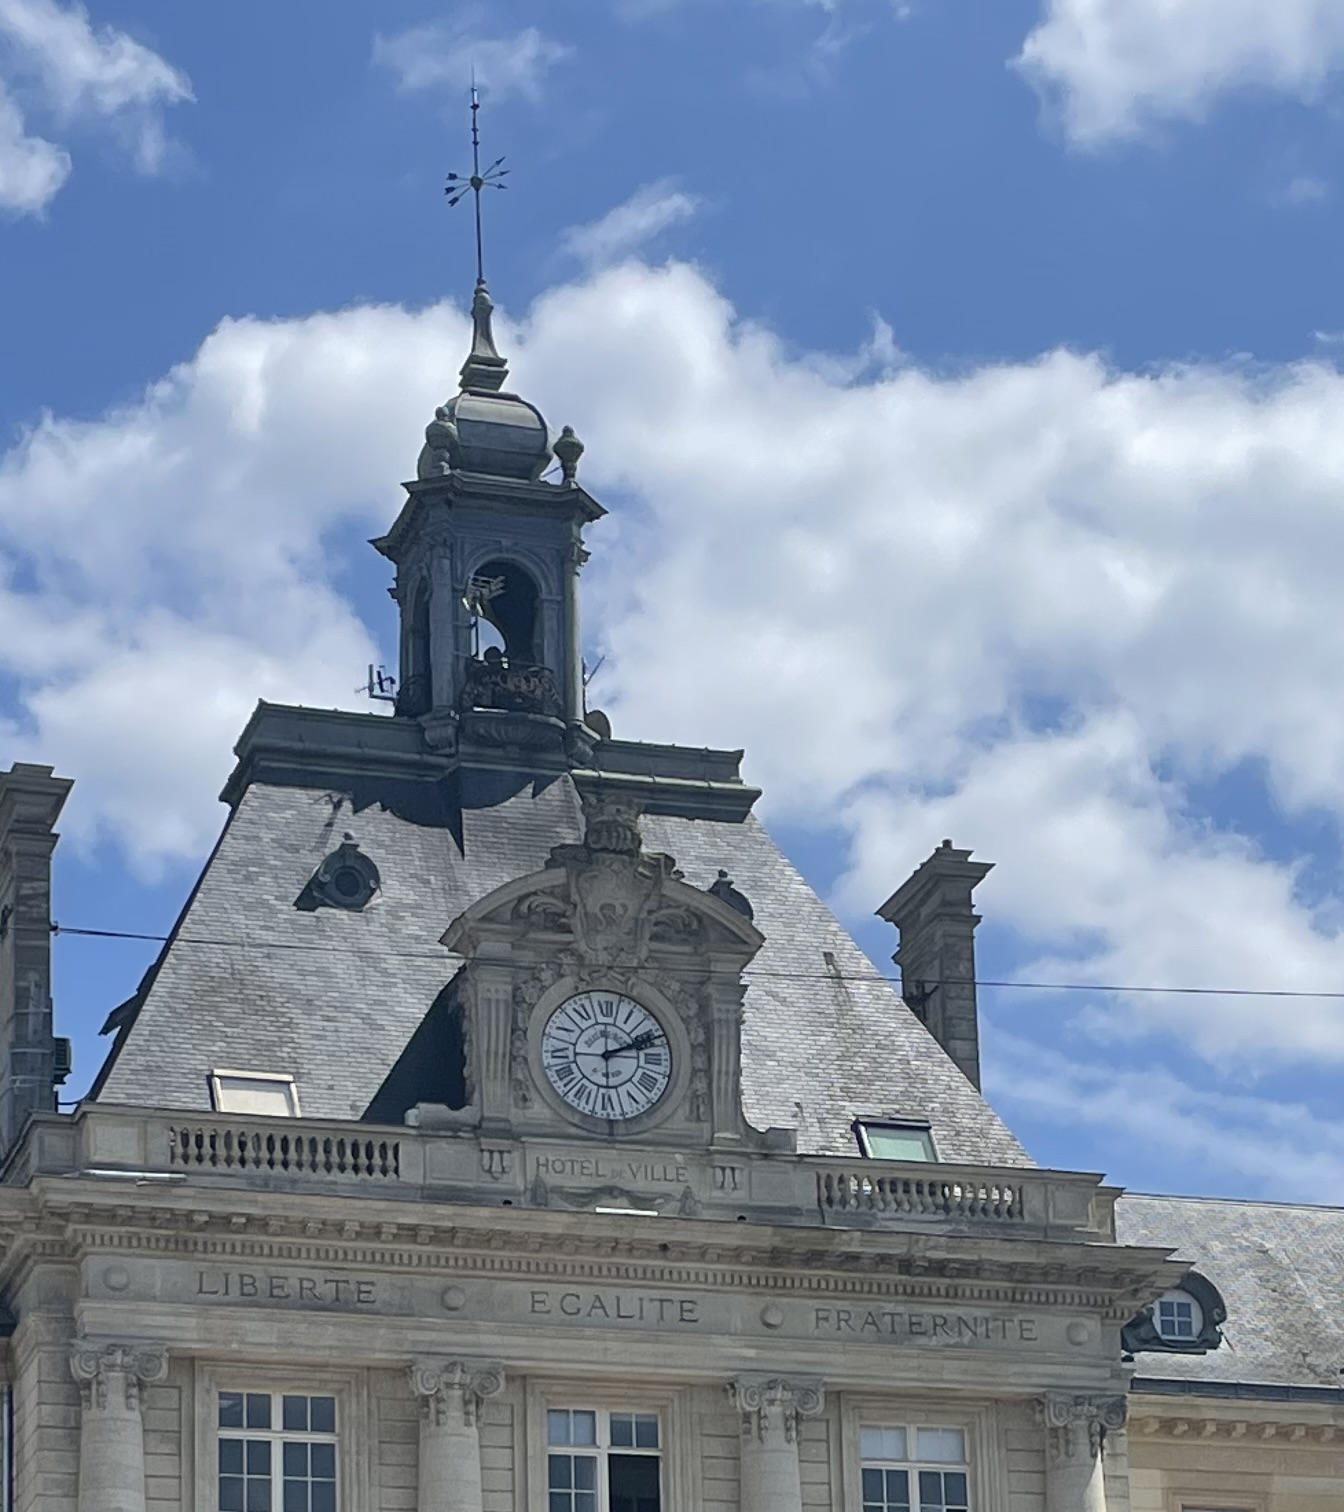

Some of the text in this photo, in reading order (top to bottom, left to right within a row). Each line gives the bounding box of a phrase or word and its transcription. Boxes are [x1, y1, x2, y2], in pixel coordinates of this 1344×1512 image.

[536, 1156, 606, 1178] HOTEL
[627, 1163, 689, 1183] VILLE
[196, 1270, 376, 1304] LIBERTE
[529, 1290, 700, 1323] EGALITE
[813, 1308, 1038, 1341] FRATERNITE
